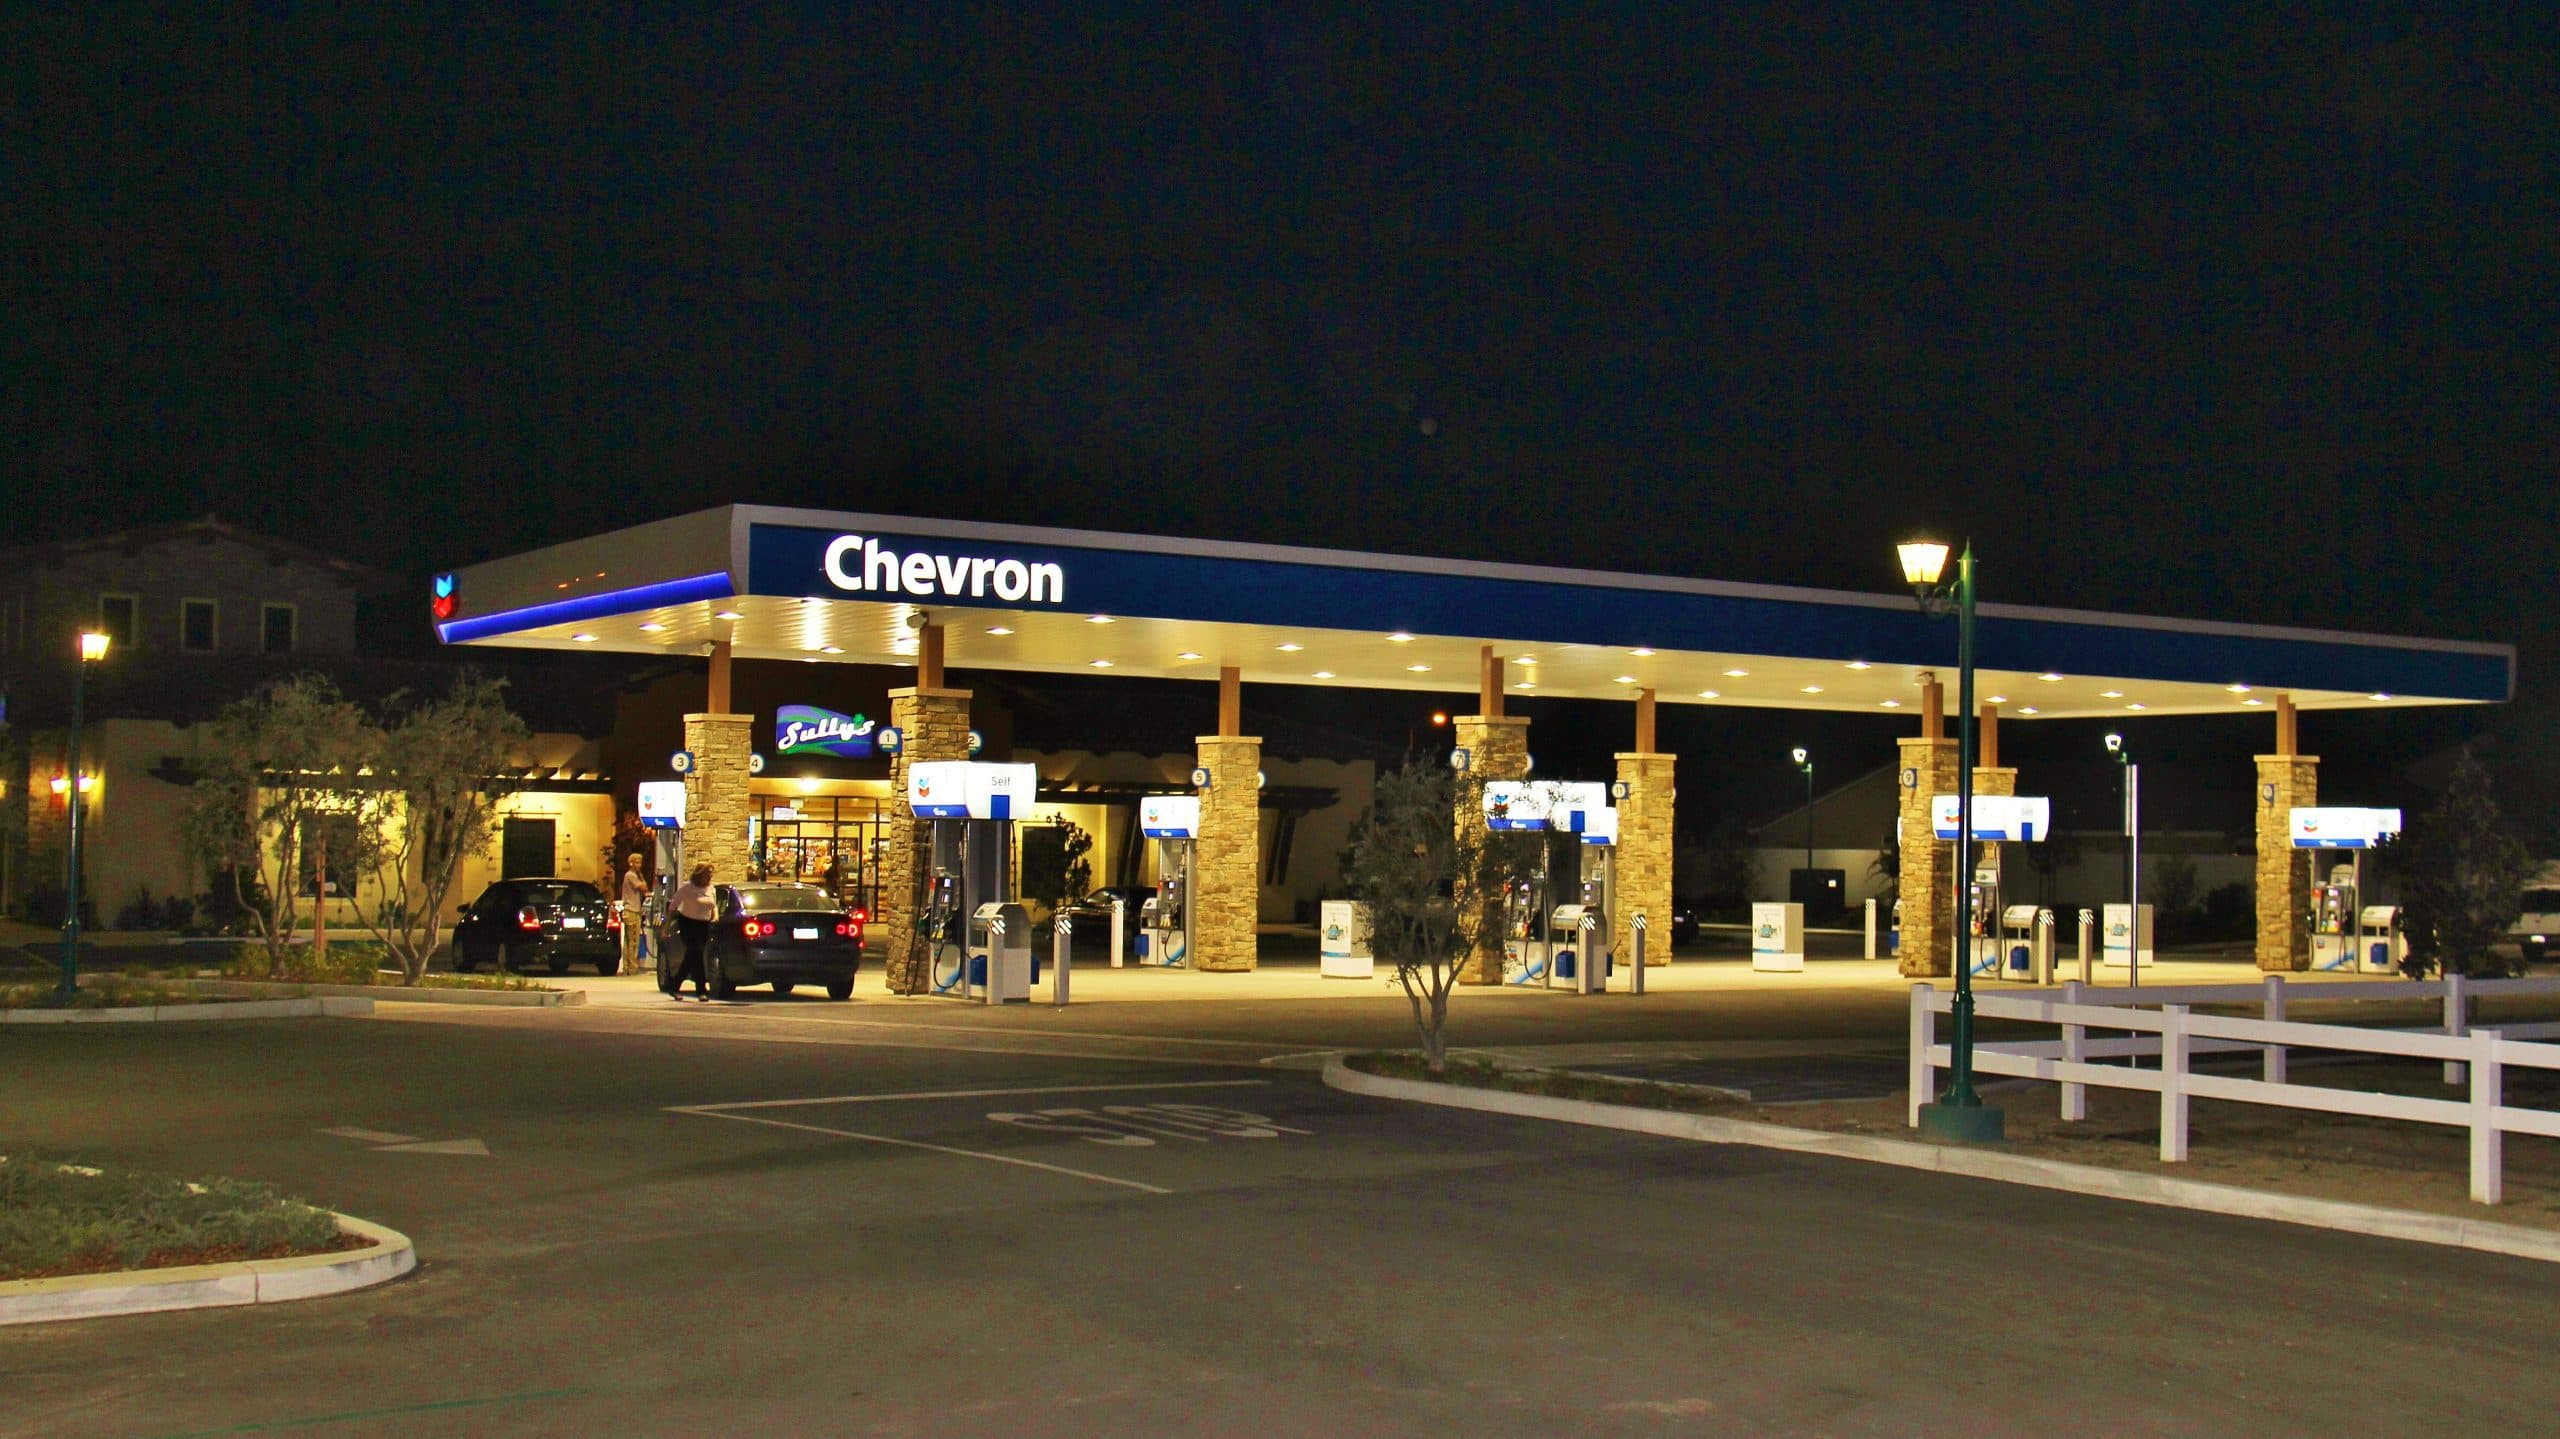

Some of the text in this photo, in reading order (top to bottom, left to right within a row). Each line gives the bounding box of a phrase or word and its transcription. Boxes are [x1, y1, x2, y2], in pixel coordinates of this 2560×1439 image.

[824, 535, 1063, 603] Chevron
[991, 776, 1011, 787] Self
[986, 1103, 1314, 1147] STOP
